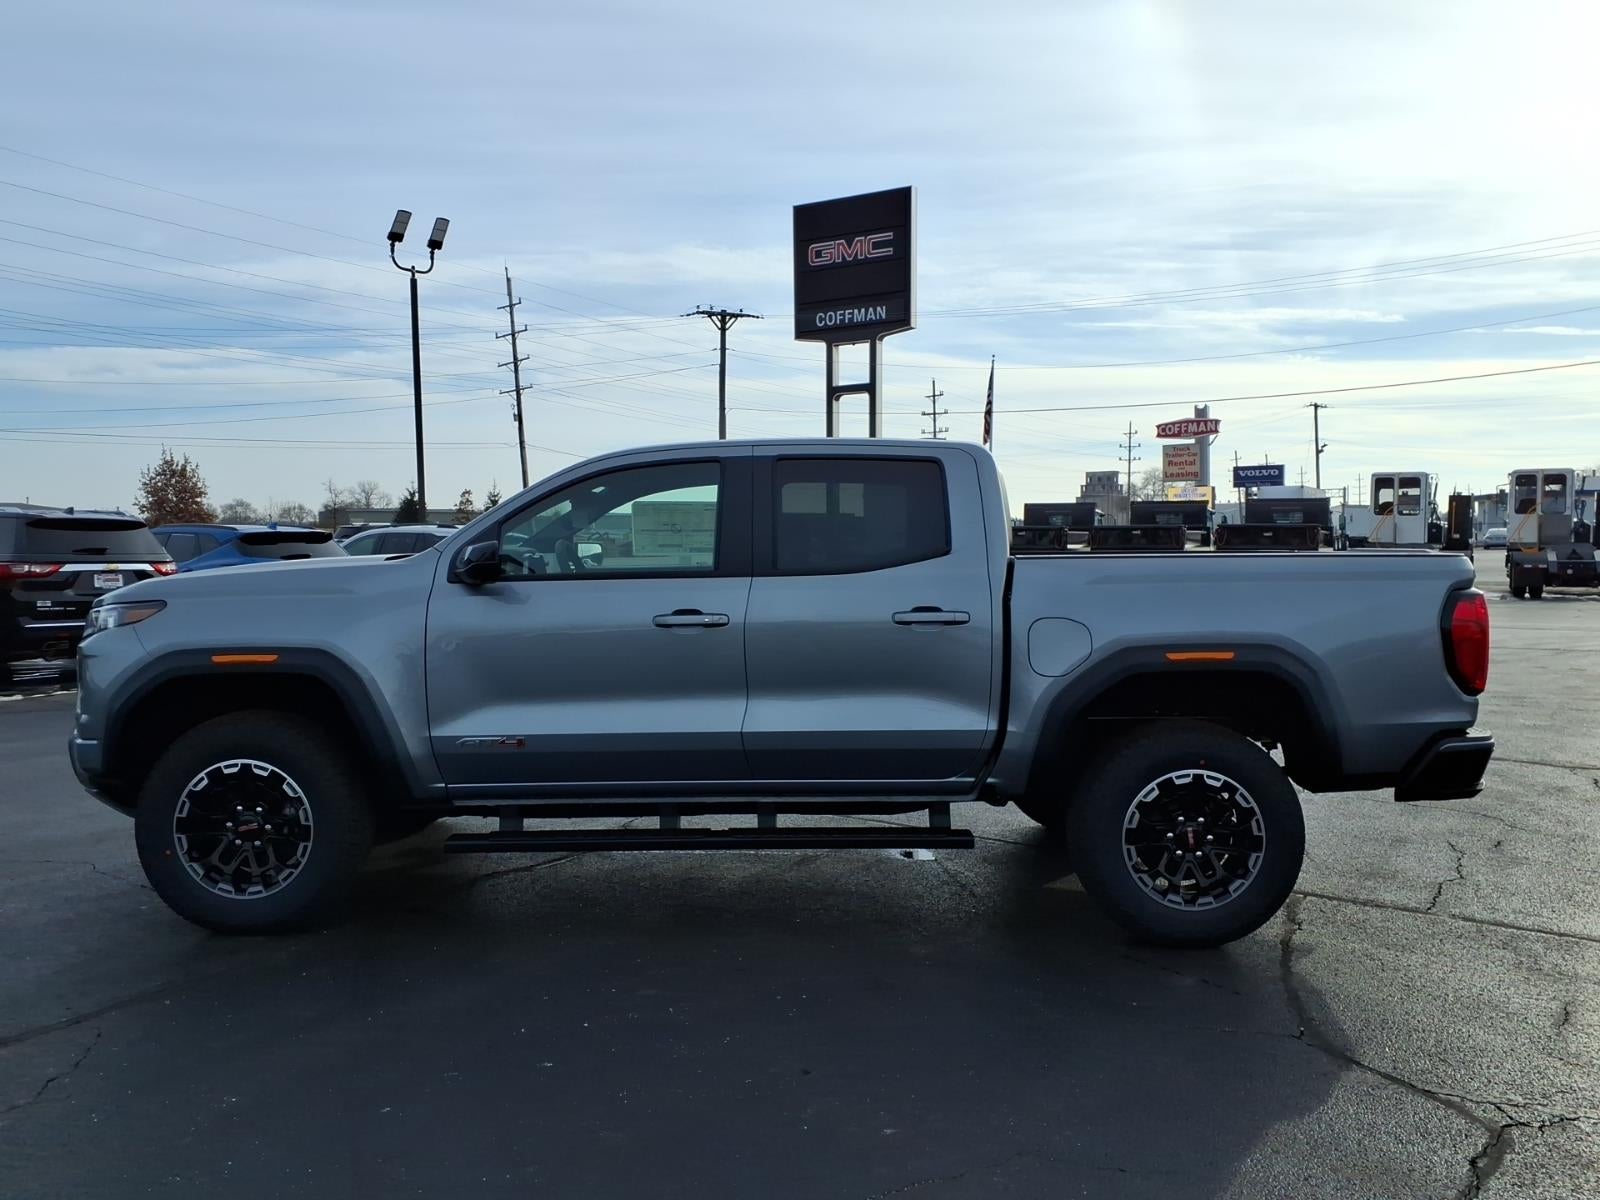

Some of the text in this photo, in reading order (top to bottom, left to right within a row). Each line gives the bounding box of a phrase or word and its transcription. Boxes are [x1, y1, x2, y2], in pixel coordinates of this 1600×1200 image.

[808, 232, 893, 266] GMC
[816, 306, 886, 327] COFFMAN
[1159, 421, 1216, 435] COFFMAN
[1168, 459, 1196, 467] Rental
[1165, 470, 1199, 479] Leasing
